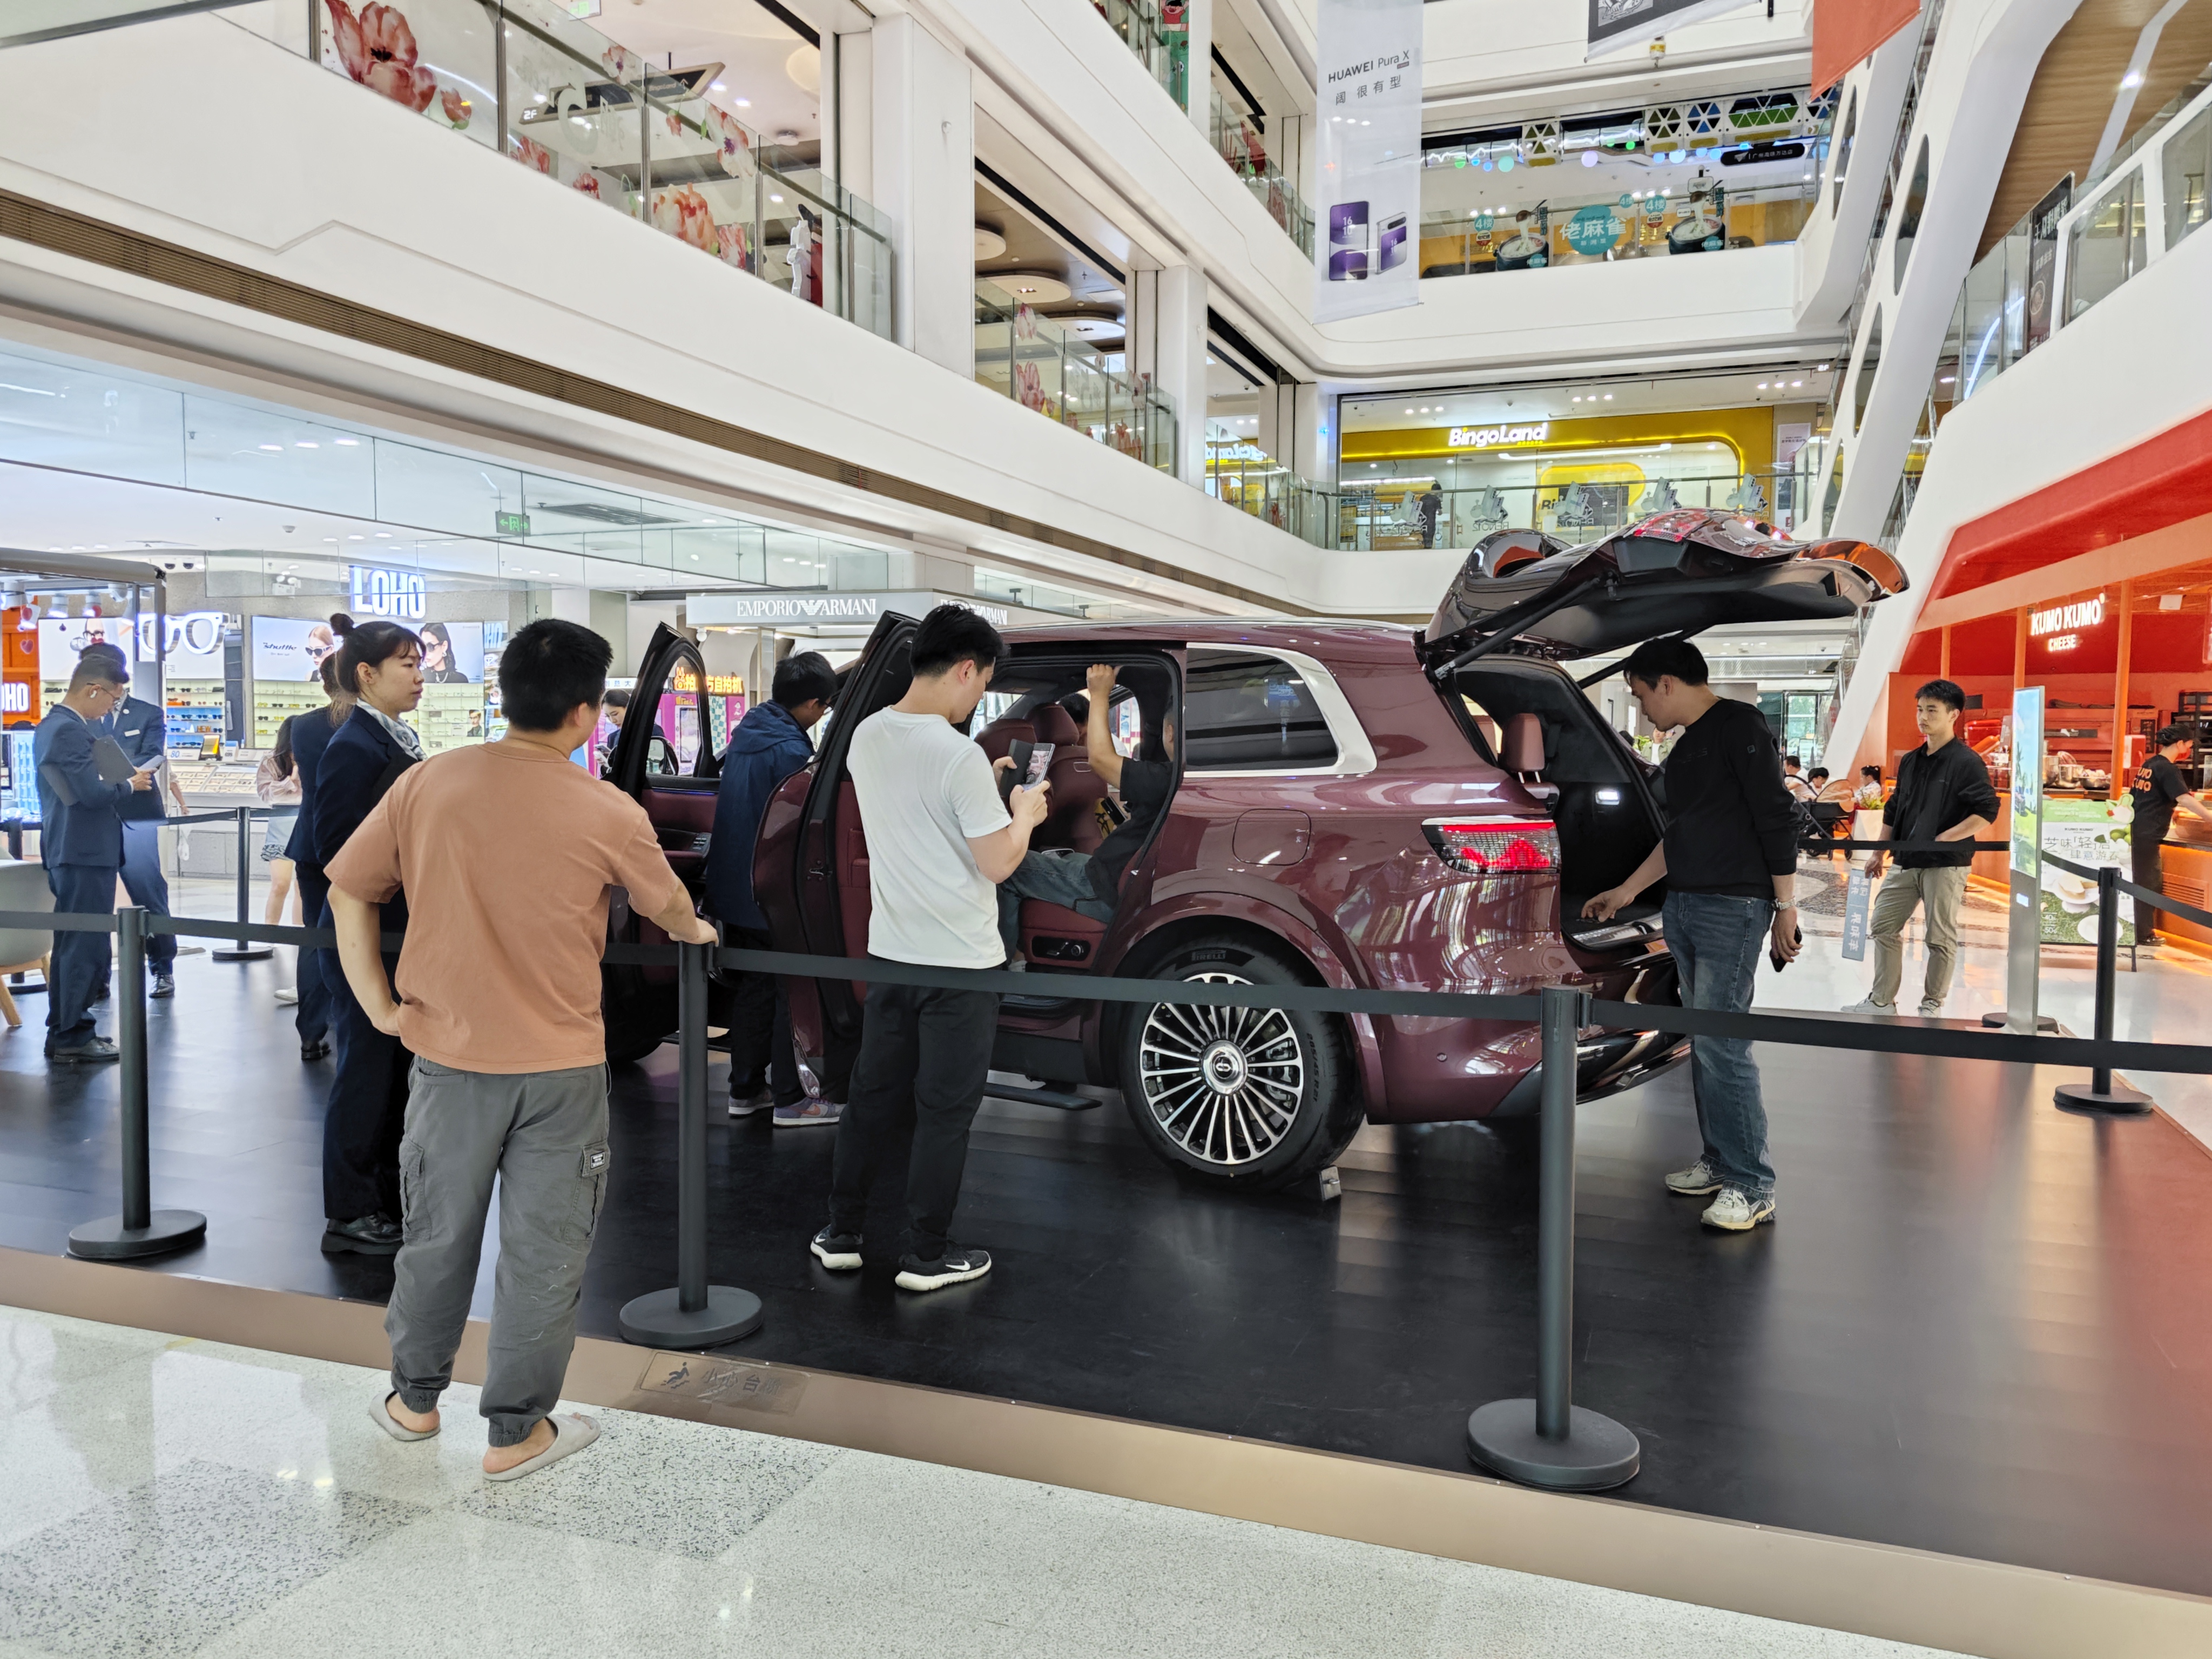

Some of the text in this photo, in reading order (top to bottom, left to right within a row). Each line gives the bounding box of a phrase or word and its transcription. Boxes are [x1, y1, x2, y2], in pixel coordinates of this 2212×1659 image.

[1328, 60, 1373, 83] HUAWEI
[1378, 55, 1399, 68] Pura
[1402, 50, 1410, 60] X
[1336, 75, 1401, 105] 阔 很有型
[524, 110, 537, 120] 2F
[1343, 216, 1352, 225] 16
[1560, 217, 1627, 241] 佬麻雀
[1448, 422, 1548, 447] BingoLand
[351, 565, 426, 619] LOHO
[737, 599, 876, 616] EMPORIO ARMANI
[2031, 599, 2101, 636] KUMO KUMO
[2048, 634, 2076, 651] CHEESE
[685, 675, 743, 693] 拍方自拍机
[2137, 767, 2153, 779] UMO
[1191, 950, 1227, 961] PIRELLI
